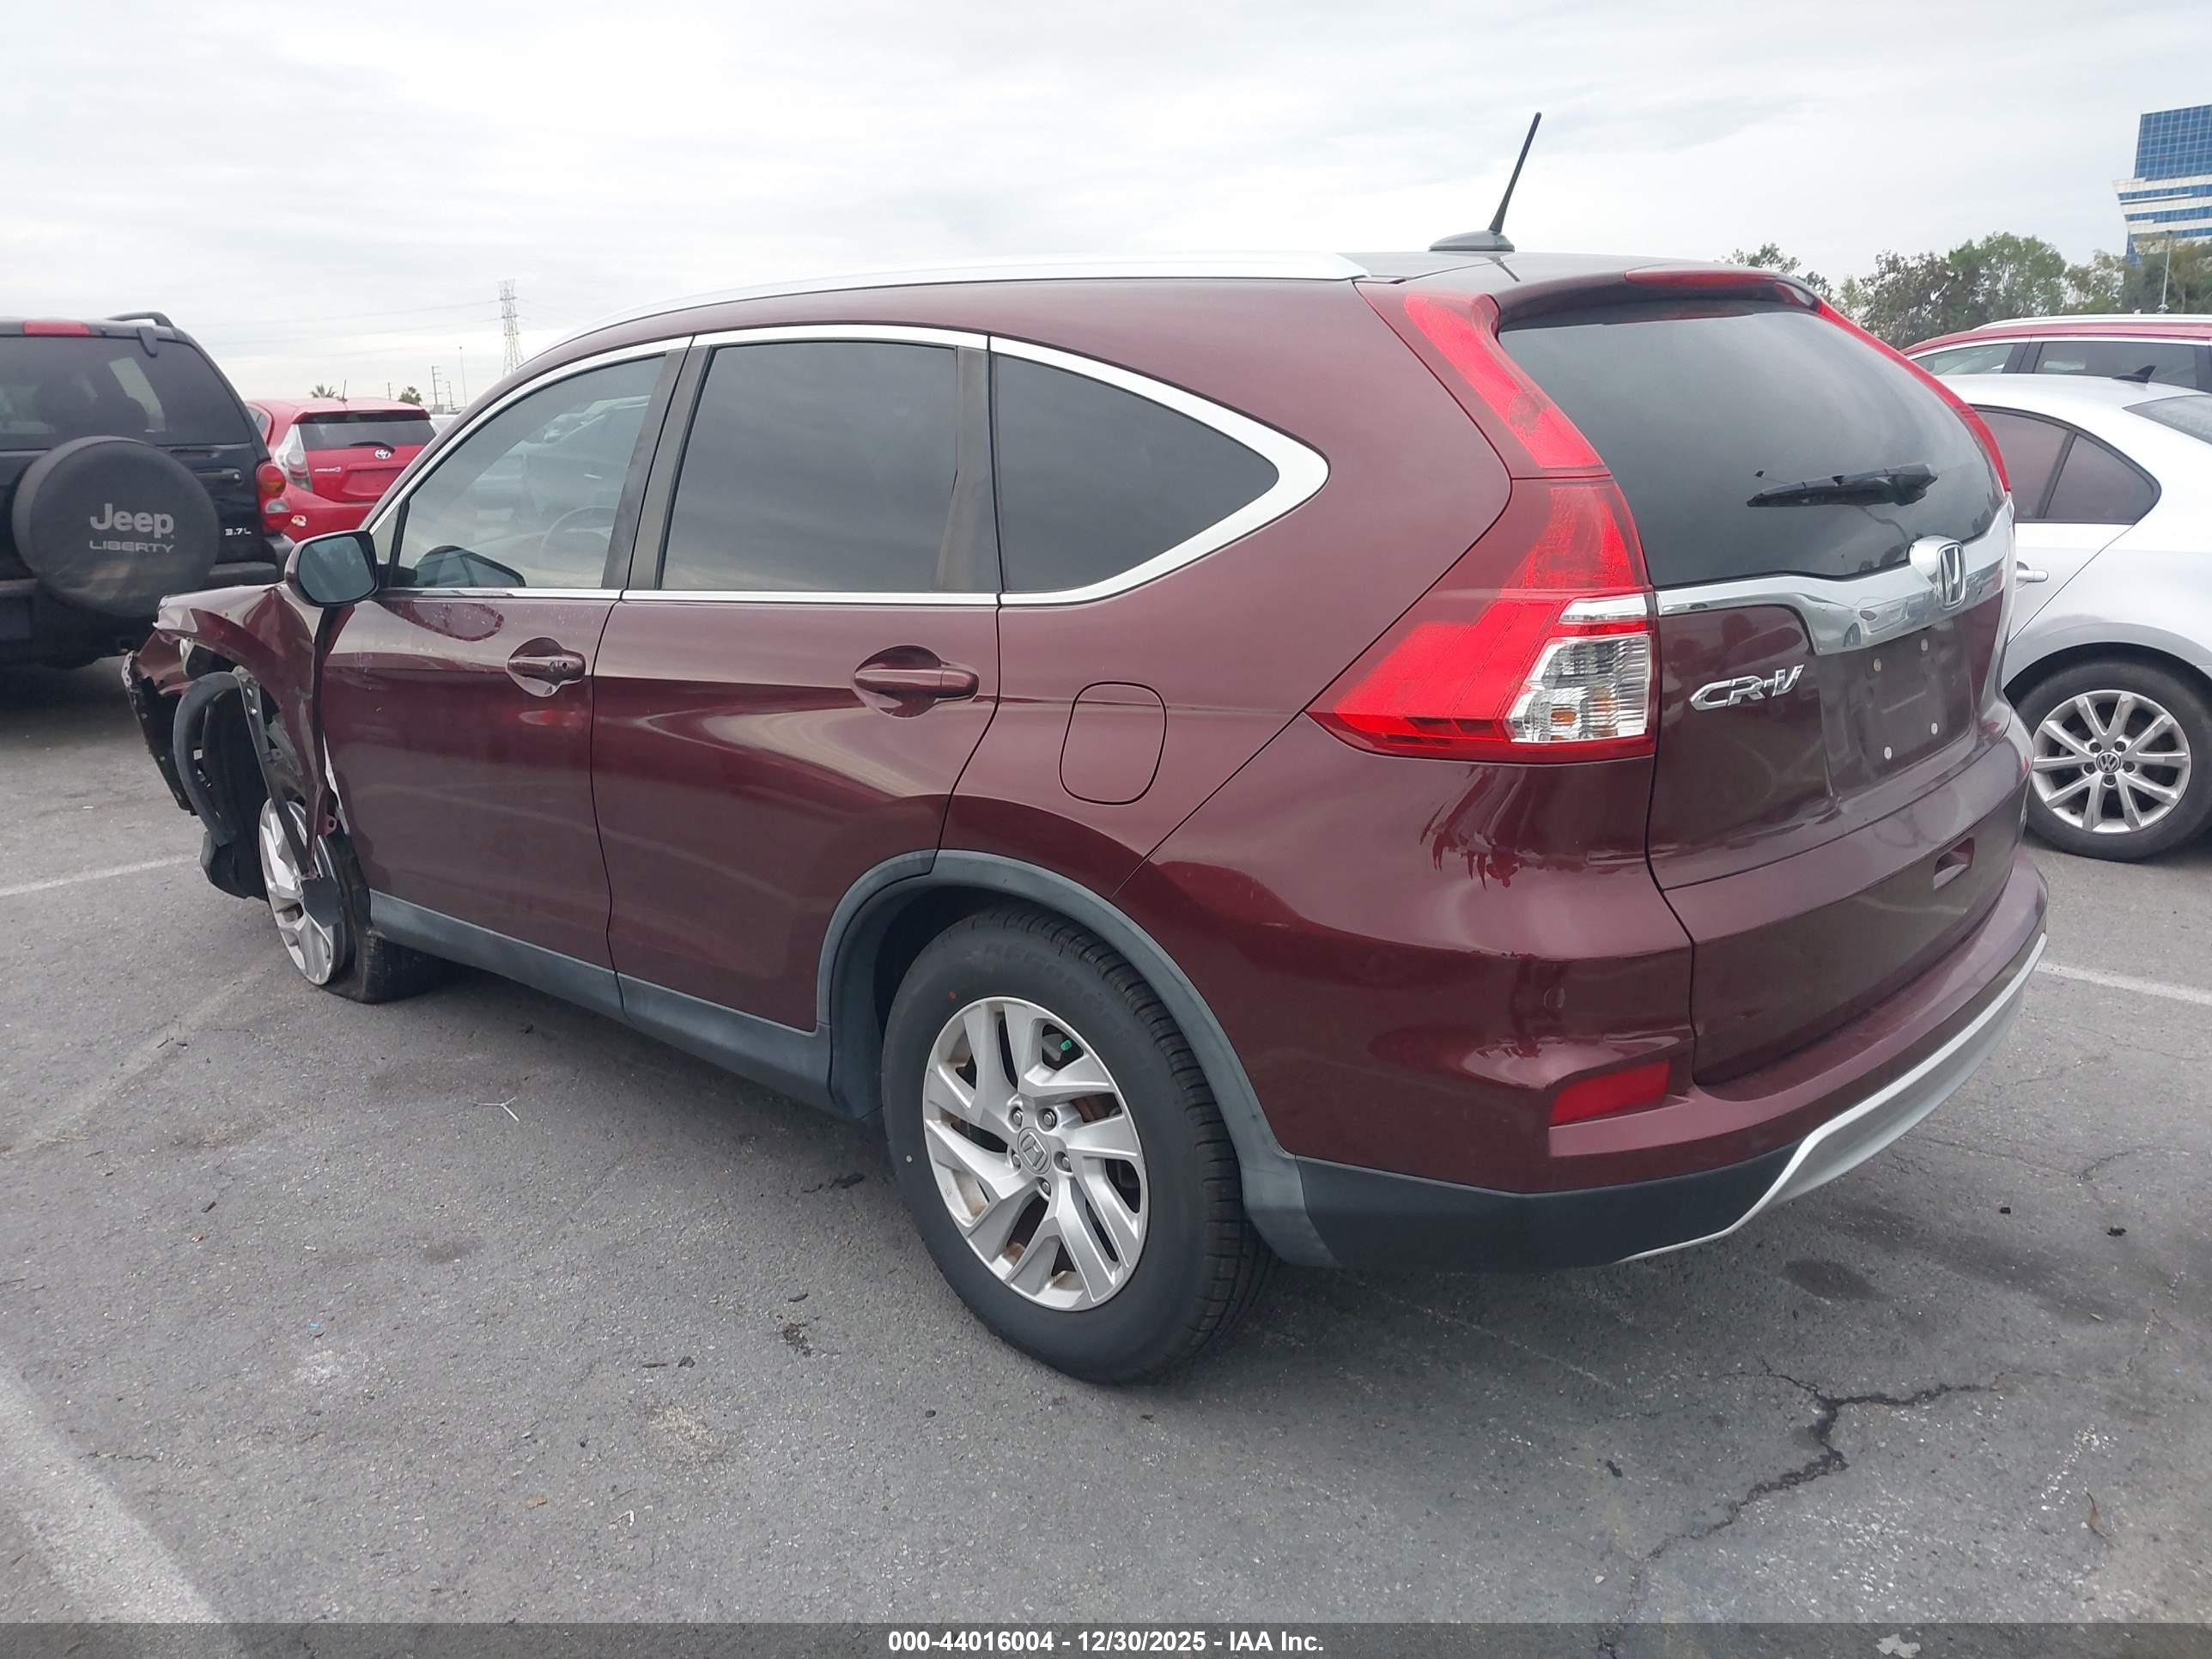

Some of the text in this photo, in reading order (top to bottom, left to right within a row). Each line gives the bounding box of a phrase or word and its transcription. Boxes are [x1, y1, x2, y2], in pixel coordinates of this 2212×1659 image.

[90, 503, 173, 538] Jeep
[89, 540, 174, 553] LIBERTY
[1690, 665, 1804, 711] CR-V
